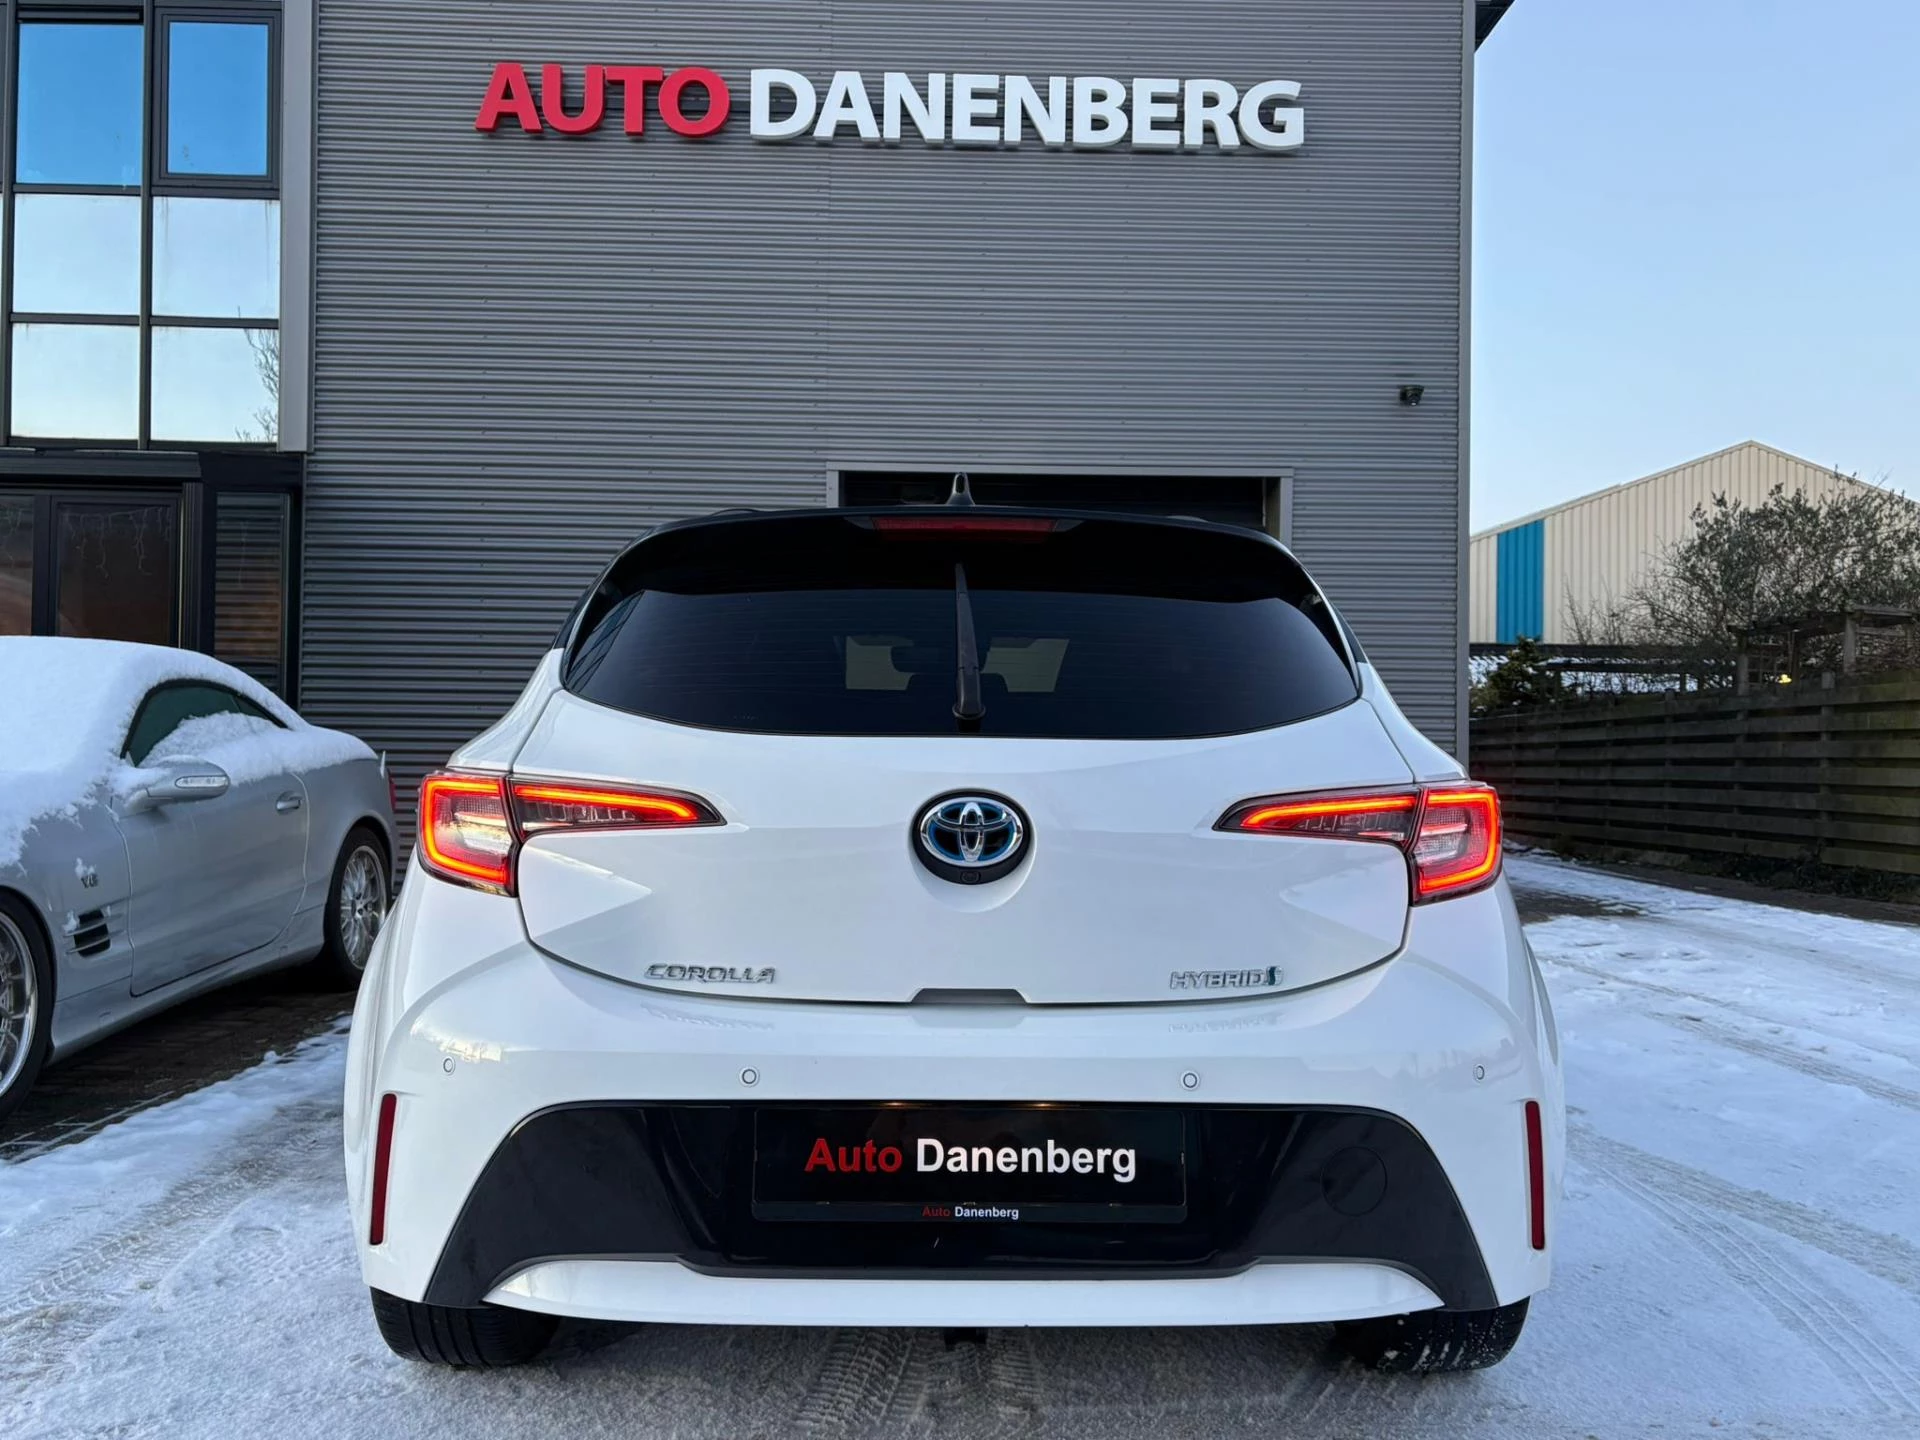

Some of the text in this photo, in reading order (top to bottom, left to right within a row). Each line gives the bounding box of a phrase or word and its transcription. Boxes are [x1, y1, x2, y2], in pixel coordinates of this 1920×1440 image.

[475, 62, 1306, 153] AUTO DANENBERG
[645, 963, 777, 983] COROLLA
[1169, 970, 1266, 990] HYBRID
[805, 1138, 1137, 1183] Auto Danenberg
[922, 1206, 1019, 1221] Auto Danenberg
